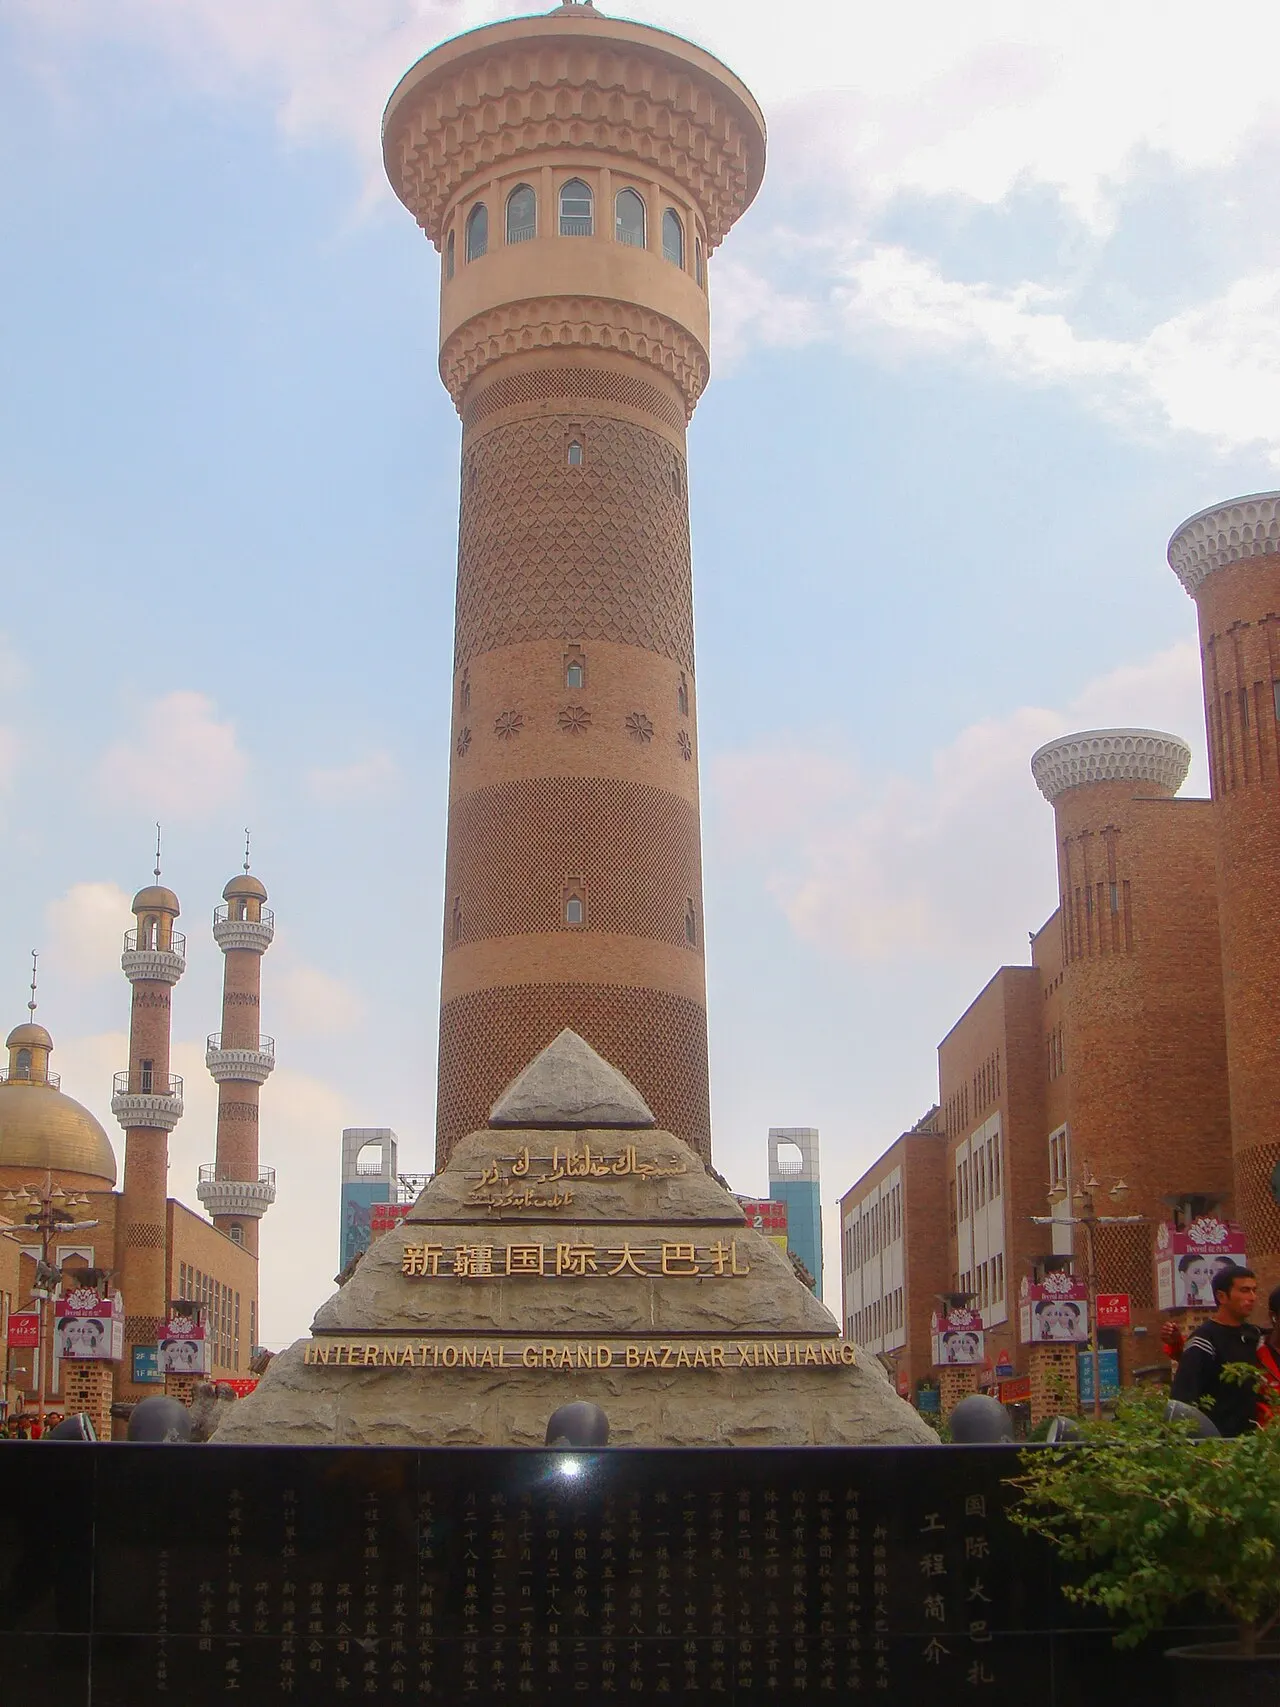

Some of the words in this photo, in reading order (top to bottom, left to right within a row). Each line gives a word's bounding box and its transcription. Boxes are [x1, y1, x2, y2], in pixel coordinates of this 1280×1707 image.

[401, 1241, 750, 1277] 新疆国际大巴扎
[303, 1343, 510, 1367] INTERNATIONAL
[522, 1346, 612, 1369] GRAND
[625, 1345, 725, 1369] BAZAAR
[736, 1343, 856, 1367] XINJIANG
[919, 1512, 951, 1665] 工程简介
[965, 1494, 995, 1686] 国际大巴扎
